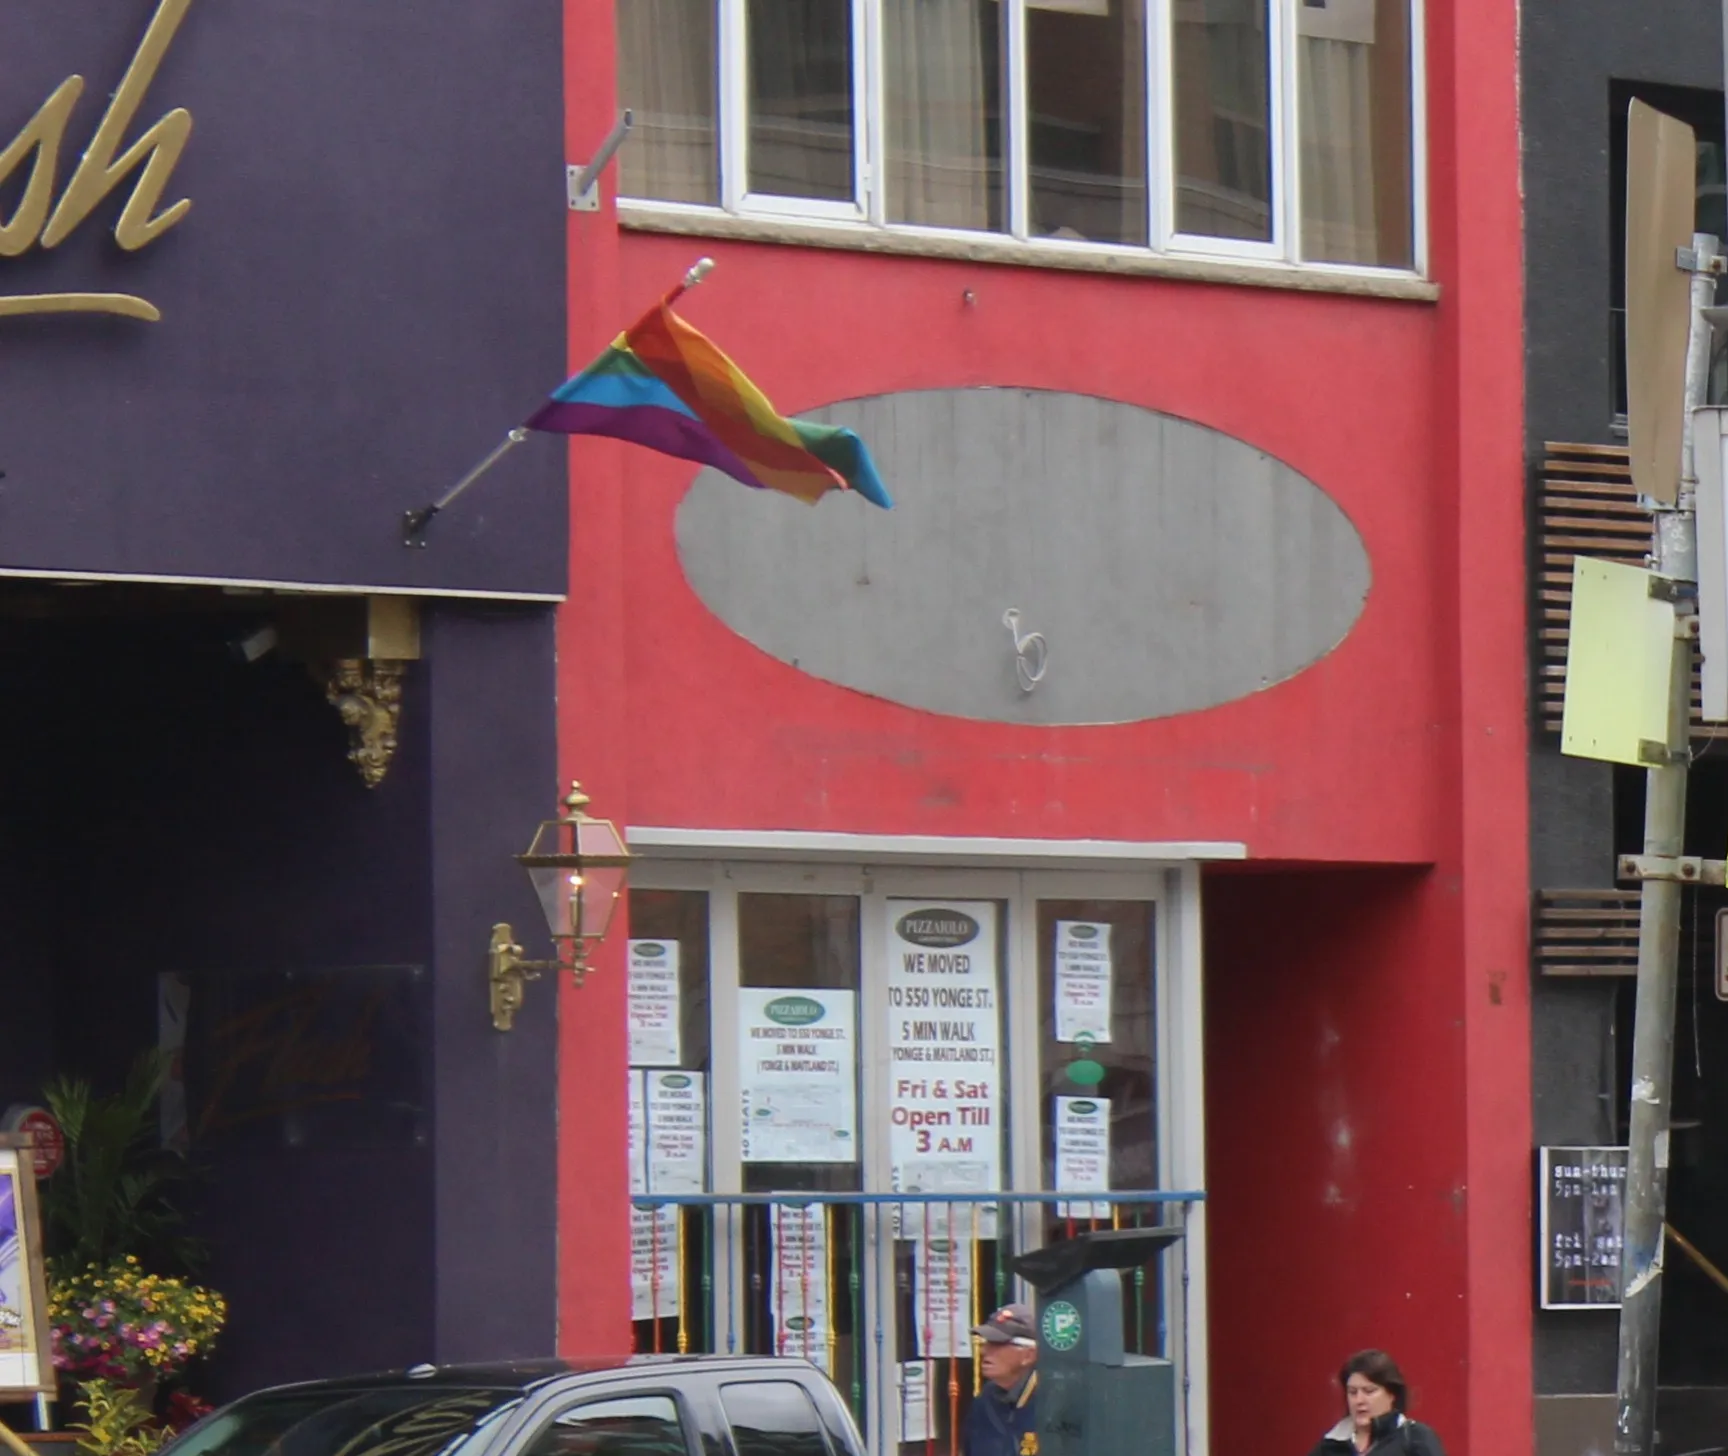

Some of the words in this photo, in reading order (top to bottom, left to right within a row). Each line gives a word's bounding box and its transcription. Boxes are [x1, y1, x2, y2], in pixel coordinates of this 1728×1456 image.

[903, 953, 925, 973] WE
[927, 954, 971, 974] MOVED
[905, 987, 929, 1008] 550
[932, 987, 973, 1008] YONGE
[902, 1021, 909, 1041] 5
[913, 1021, 937, 1041] MIN
[939, 1021, 975, 1041] WALK
[897, 1080, 927, 1099] Fri
[932, 1080, 948, 1099] &
[954, 1079, 988, 1099] Sat
[891, 1106, 951, 1130] Open
[956, 1106, 990, 1126] Till
[916, 1130, 931, 1152] 3
